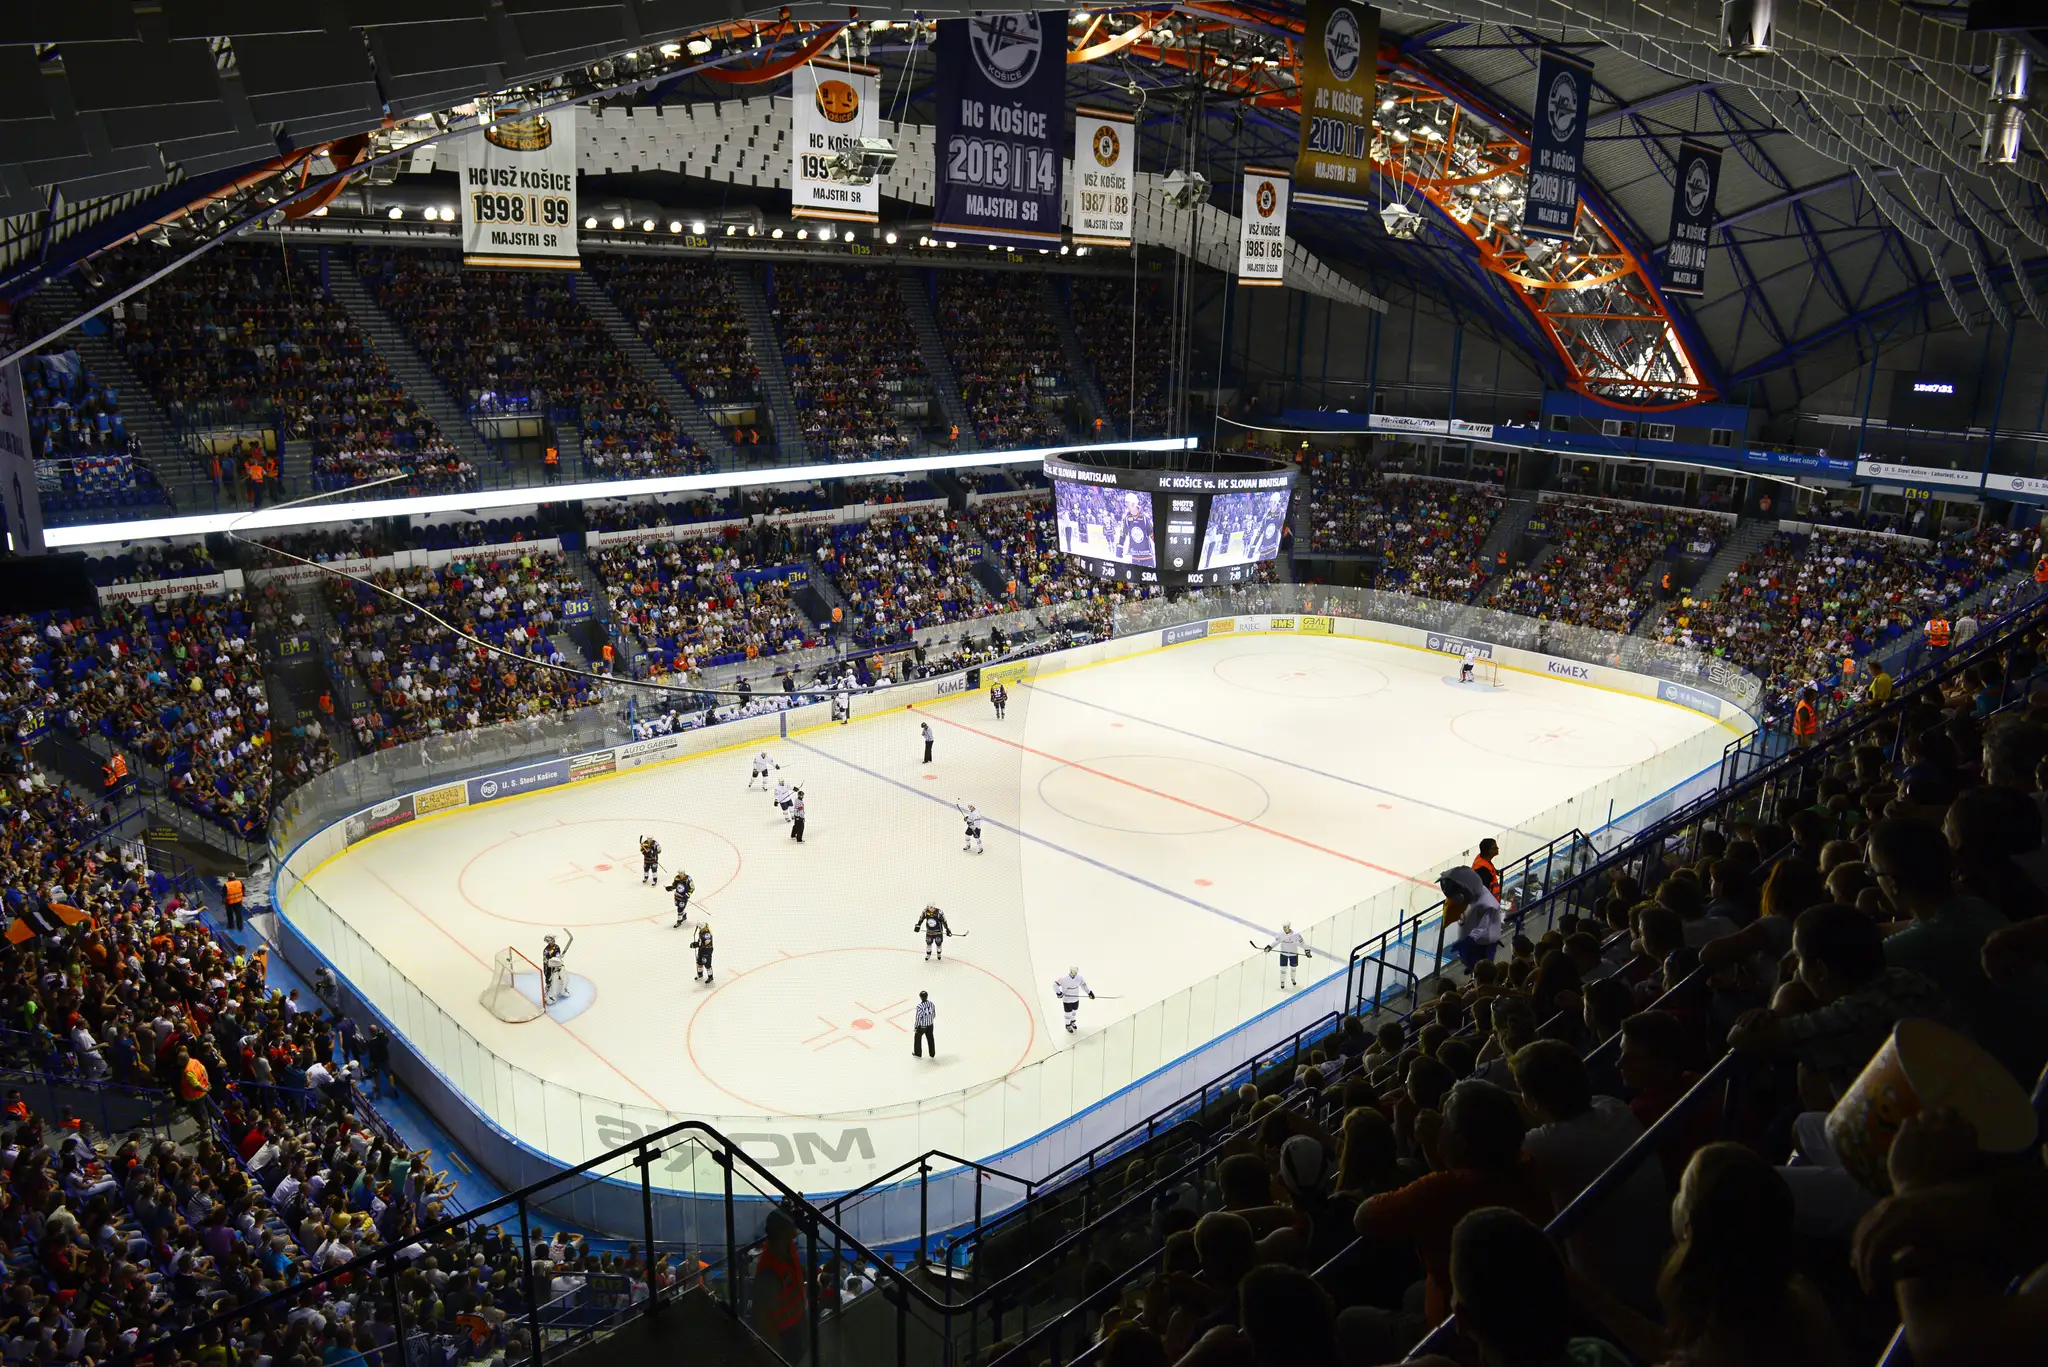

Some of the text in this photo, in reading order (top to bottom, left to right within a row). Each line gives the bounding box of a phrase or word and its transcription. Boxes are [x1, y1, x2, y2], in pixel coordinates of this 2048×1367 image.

[962, 99, 1047, 139] HC KOŠICE
[810, 133, 824, 149] HC
[1307, 117, 1345, 155] 2010
[947, 136, 1056, 195] 2013 14
[1315, 162, 1357, 183] MAJSTRI SR
[469, 166, 571, 191] HC VSŽ KOŠICE
[1084, 171, 1126, 189] VSŽ KOŠICE
[1530, 171, 1558, 201] 2009
[813, 188, 861, 203] MAJSTRI SR
[1081, 191, 1129, 215] 1987 88
[472, 193, 570, 226] 1998 99
[966, 194, 1038, 221] MAJSTRI SR
[1084, 218, 1108, 230] MAJSTRI
[1248, 221, 1281, 237] VSŽ KOŠICE
[492, 231, 557, 247] MAJSTRI SR
[1245, 238, 1283, 259] 1985 86
[1668, 243, 1690, 268] 2008
[1468, 425, 1491, 433] ANTIK
[1058, 468, 1077, 479] SLOVAN
[1078, 470, 1117, 484] BRATISLAVA
[1159, 476, 1288, 489] HC KOŠICE vs. HC SLOVAN BRATISLAVA
[1172, 500, 1194, 508] SHOTS
[771, 513, 836, 527] www.steelarena.sk
[600, 530, 675, 545] www.steelarena.sk
[1169, 537, 1192, 545] 16 11
[452, 545, 539, 562] www.steelarena.sk
[1101, 566, 1116, 577] 7:49
[1126, 570, 1132, 579] 0
[1141, 572, 1158, 582] SBA
[1187, 574, 1203, 583] KOS
[1212, 573, 1218, 582] 0
[106, 580, 219, 601] www.steelarena.sk
[1239, 623, 1260, 631] RAJEC
[1271, 619, 1294, 628] RMS
[1548, 661, 1589, 679] KiMEX
[623, 745, 645, 755] AUTO
[646, 737, 678, 750] GABRIEL
[502, 781, 510, 789] U.
[519, 775, 536, 786] Steel
[537, 771, 558, 782] Košice
